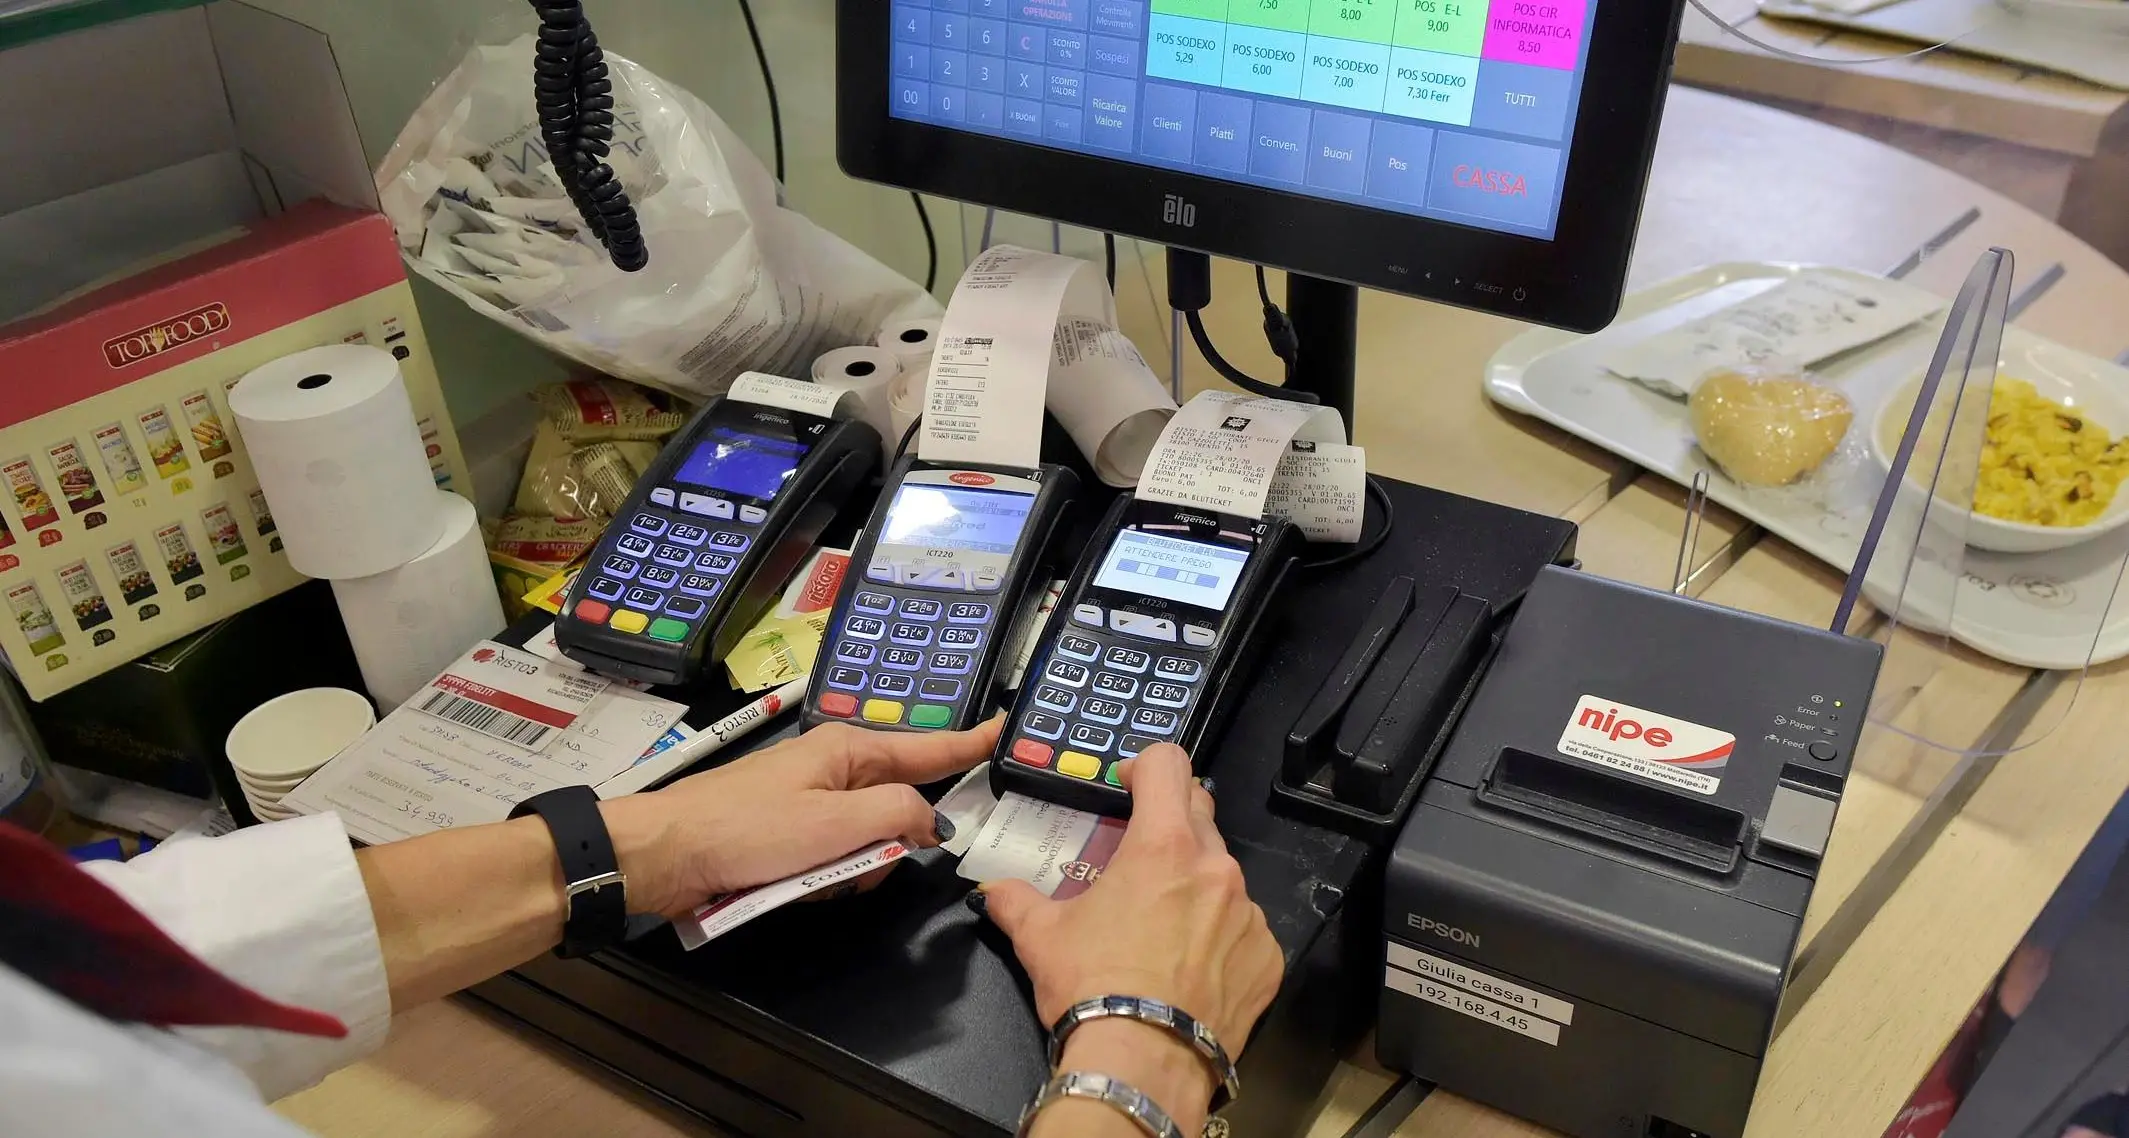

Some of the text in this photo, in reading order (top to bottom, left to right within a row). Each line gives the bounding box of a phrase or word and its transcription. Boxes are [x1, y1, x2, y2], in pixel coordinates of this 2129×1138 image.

[1340, 8, 1362, 20] 8,00
[1414, 0, 1462, 16] POS E-L
[1513, 3, 1558, 19] POS CIR
[908, 18, 916, 32] 4
[944, 24, 952, 38] 5
[1427, 20, 1449, 32] 9,00
[1493, 18, 1572, 40] INFORMATICA
[982, 30, 991, 44] 6
[1020, 36, 1031, 50] C
[1156, 32, 1216, 50] POS SODEXO
[1232, 44, 1296, 62] POS SODEXO
[1518, 40, 1541, 54] 8,50
[908, 55, 914, 68] 1
[1175, 52, 1194, 64] 5,29
[1313, 55, 1378, 75] POS SODEXO
[944, 60, 952, 75] 2
[981, 66, 989, 80] 3
[1252, 64, 1272, 76] 6,00
[1020, 73, 1029, 88] X
[1334, 76, 1354, 88] 7,00
[1397, 68, 1466, 88] POS SODEXO
[903, 90, 918, 105] 00
[1407, 86, 1450, 102] 7,30 Ferr
[1504, 92, 1536, 108] TUTTI
[942, 97, 950, 110] 0
[1092, 98, 1127, 113] Ricarica
[1094, 114, 1123, 128] Valore
[1152, 117, 1182, 132] Clienti
[1210, 126, 1234, 140] Piatti
[1259, 136, 1298, 152] Conven.
[1323, 146, 1352, 162] Buoni
[1388, 158, 1408, 171] Pos
[1453, 164, 1528, 198] CASSA
[162, 310, 224, 346] FOOD
[1156, 464, 1182, 472] TICKET
[1147, 487, 1174, 497] GRAZIE
[1174, 512, 1217, 527] ingenico
[1124, 546, 1212, 569] ATTENDERE PREGO
[596, 580, 607, 590] F
[835, 670, 846, 681] F
[1797, 705, 1820, 716] Error
[1032, 716, 1043, 727] F
[1578, 707, 1673, 748] nipe
[1789, 719, 1816, 732] Paper
[1782, 738, 1806, 750] Feed
[1565, 745, 1708, 790] tel. 0461 82 24 88 www.nipe.it
[1407, 912, 1480, 948] EPSON
[1416, 958, 1540, 1009] Giulia cassa 1
[1415, 982, 1529, 1031] 192.168.4.45
